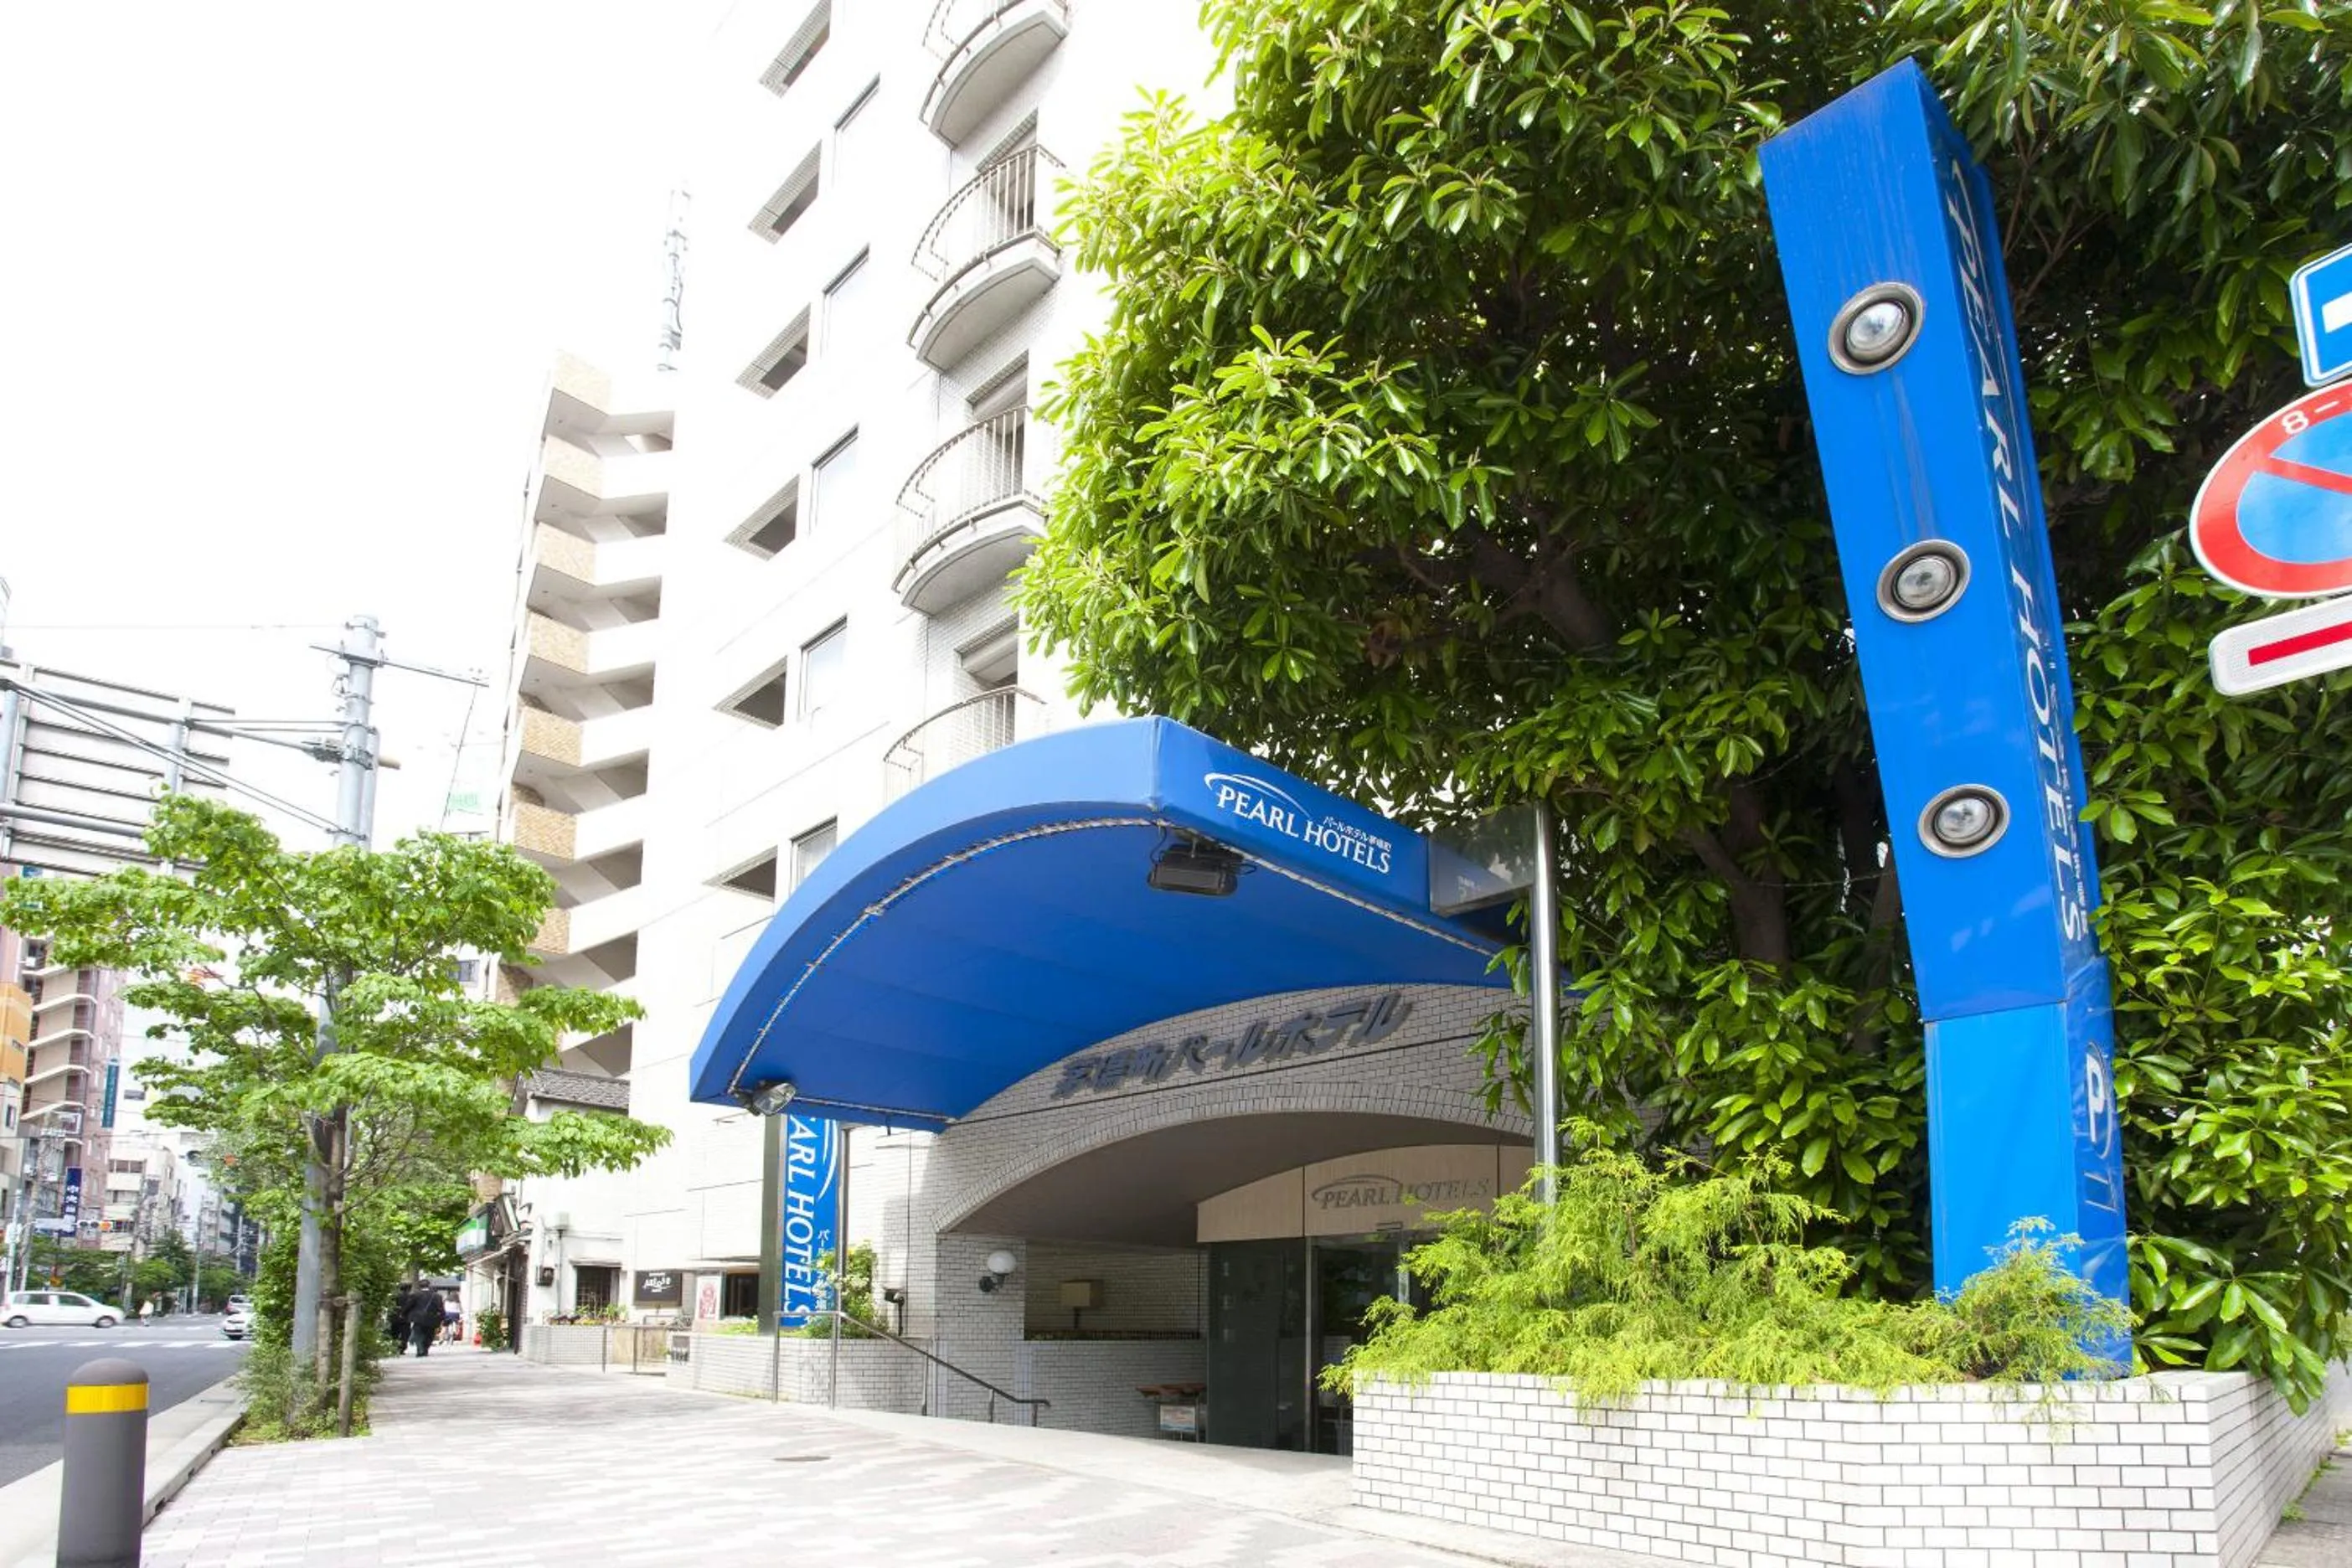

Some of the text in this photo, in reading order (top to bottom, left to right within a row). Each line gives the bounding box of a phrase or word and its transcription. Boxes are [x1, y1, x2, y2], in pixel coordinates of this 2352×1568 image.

[1945, 188, 2023, 539] PEARL
[2010, 562, 2083, 942] HOTELS
[1215, 784, 1390, 874] PEARL HOTELS
[785, 1115, 818, 1325] ARL HOTELS
[1320, 1186, 1391, 1210] PEARL
